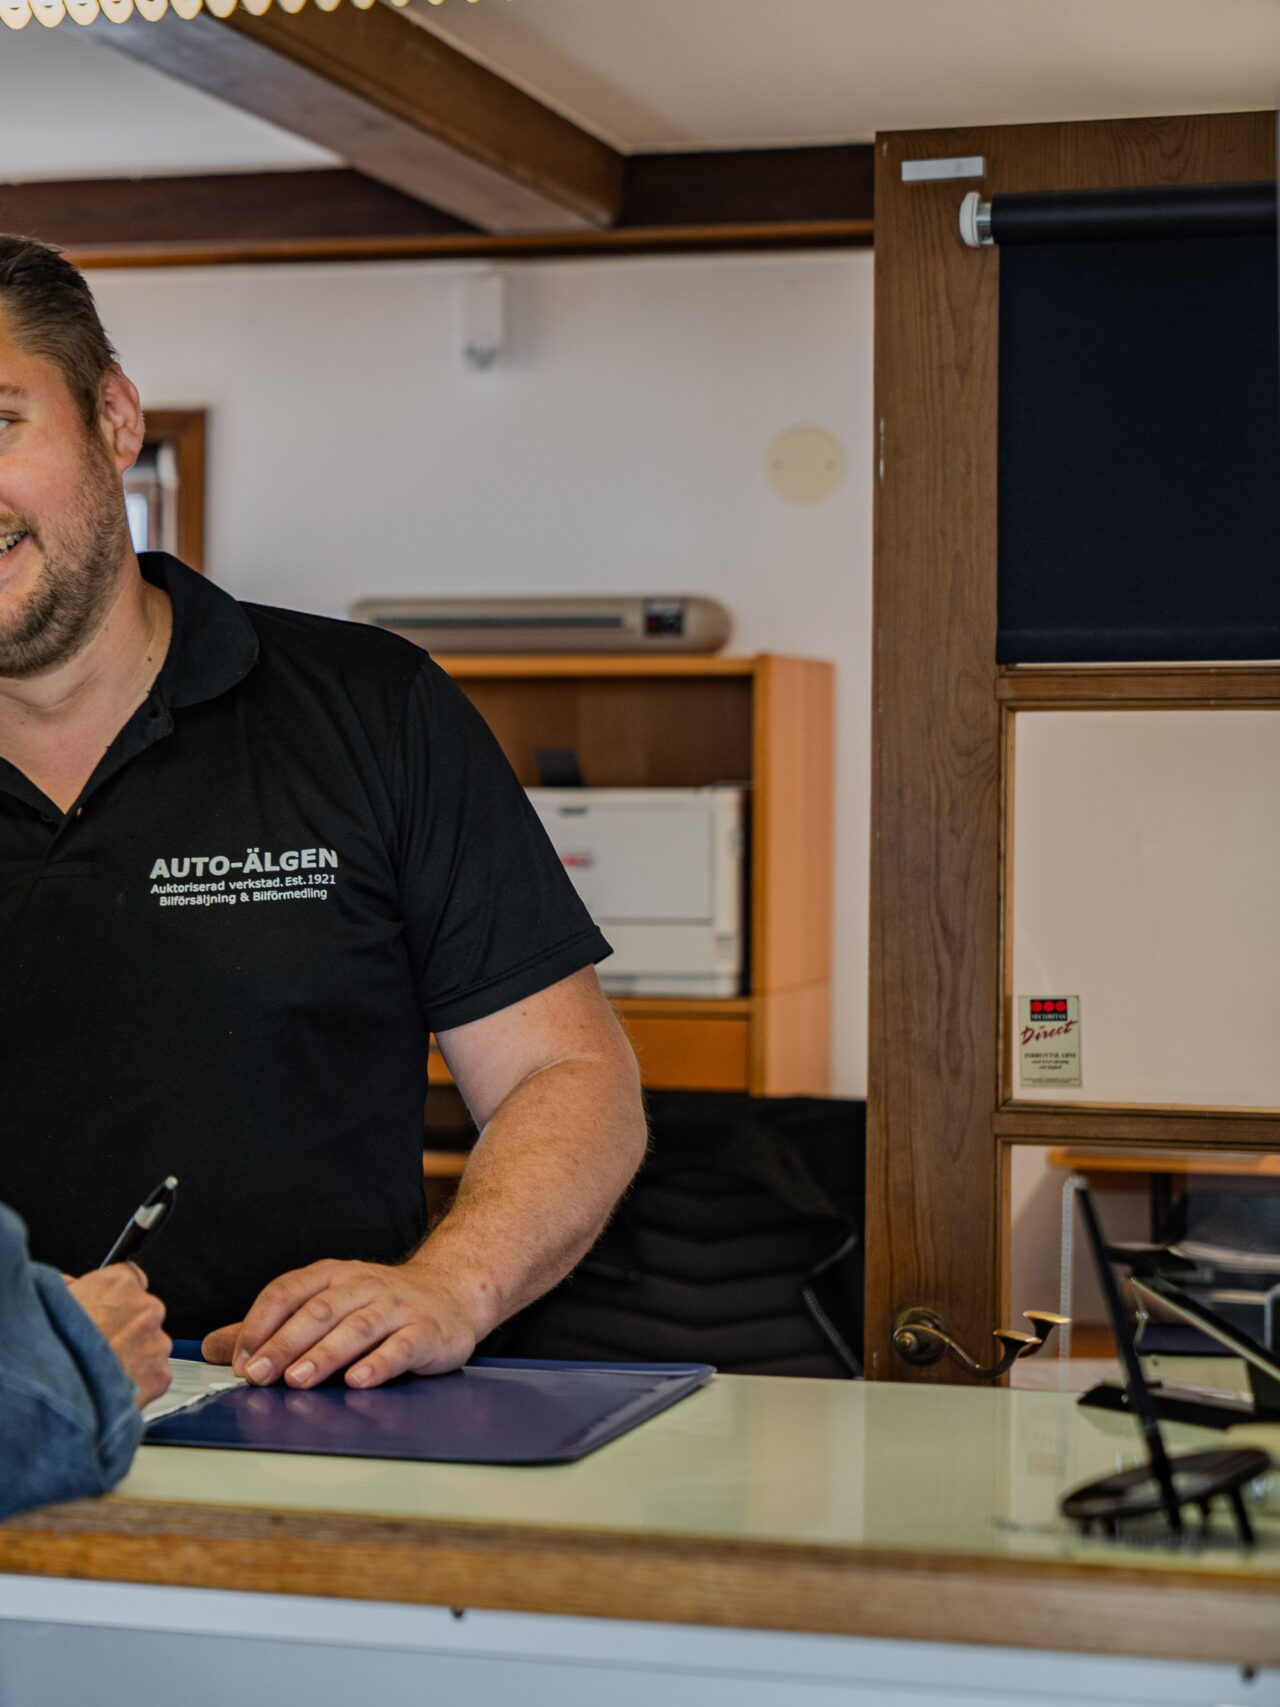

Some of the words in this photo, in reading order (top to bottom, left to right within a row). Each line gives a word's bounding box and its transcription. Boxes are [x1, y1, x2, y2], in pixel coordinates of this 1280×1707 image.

[149, 847, 338, 879] AUTO-ÄLGEN
[150, 881, 225, 894] Auktoriserad
[159, 894, 236, 906] Bilförsäljning
[240, 892, 250, 902] &
[252, 888, 328, 901] Bilförmedling
[1021, 1020, 1079, 1045] Direct
